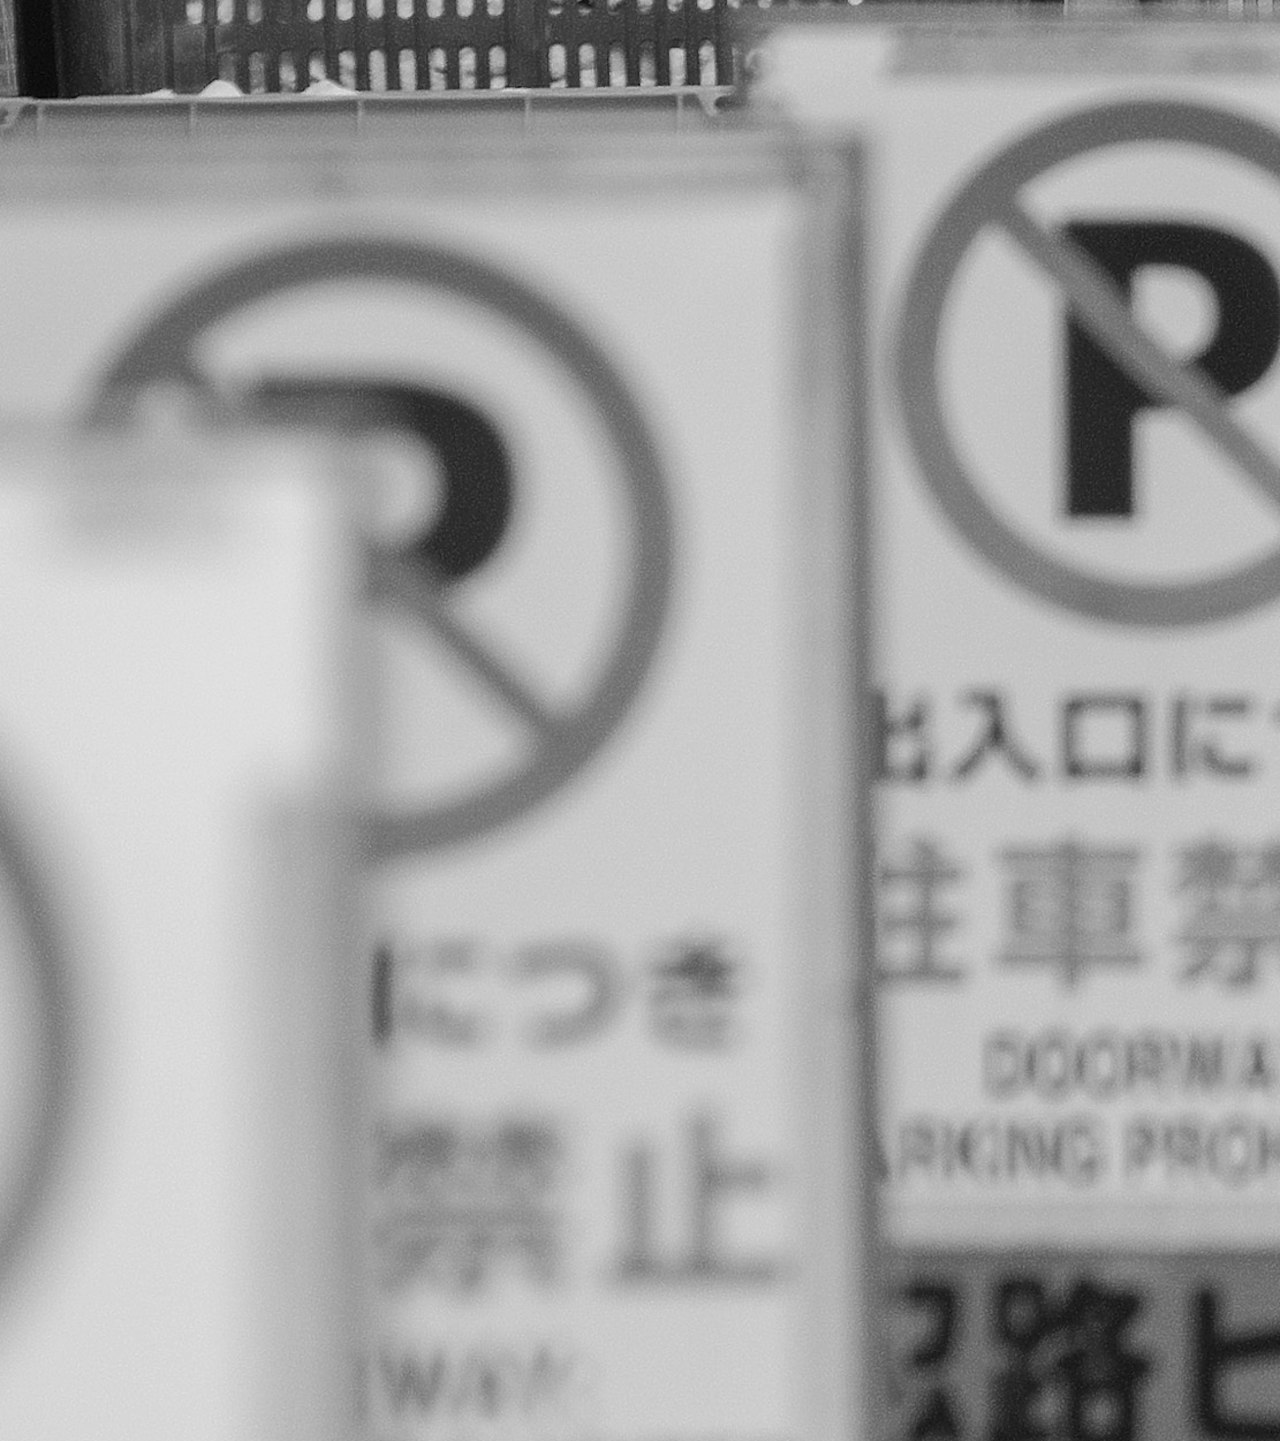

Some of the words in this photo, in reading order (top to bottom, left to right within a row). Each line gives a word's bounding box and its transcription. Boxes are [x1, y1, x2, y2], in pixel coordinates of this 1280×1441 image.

[368, 937, 737, 1053] につき
[370, 1101, 797, 1296] 禁止
